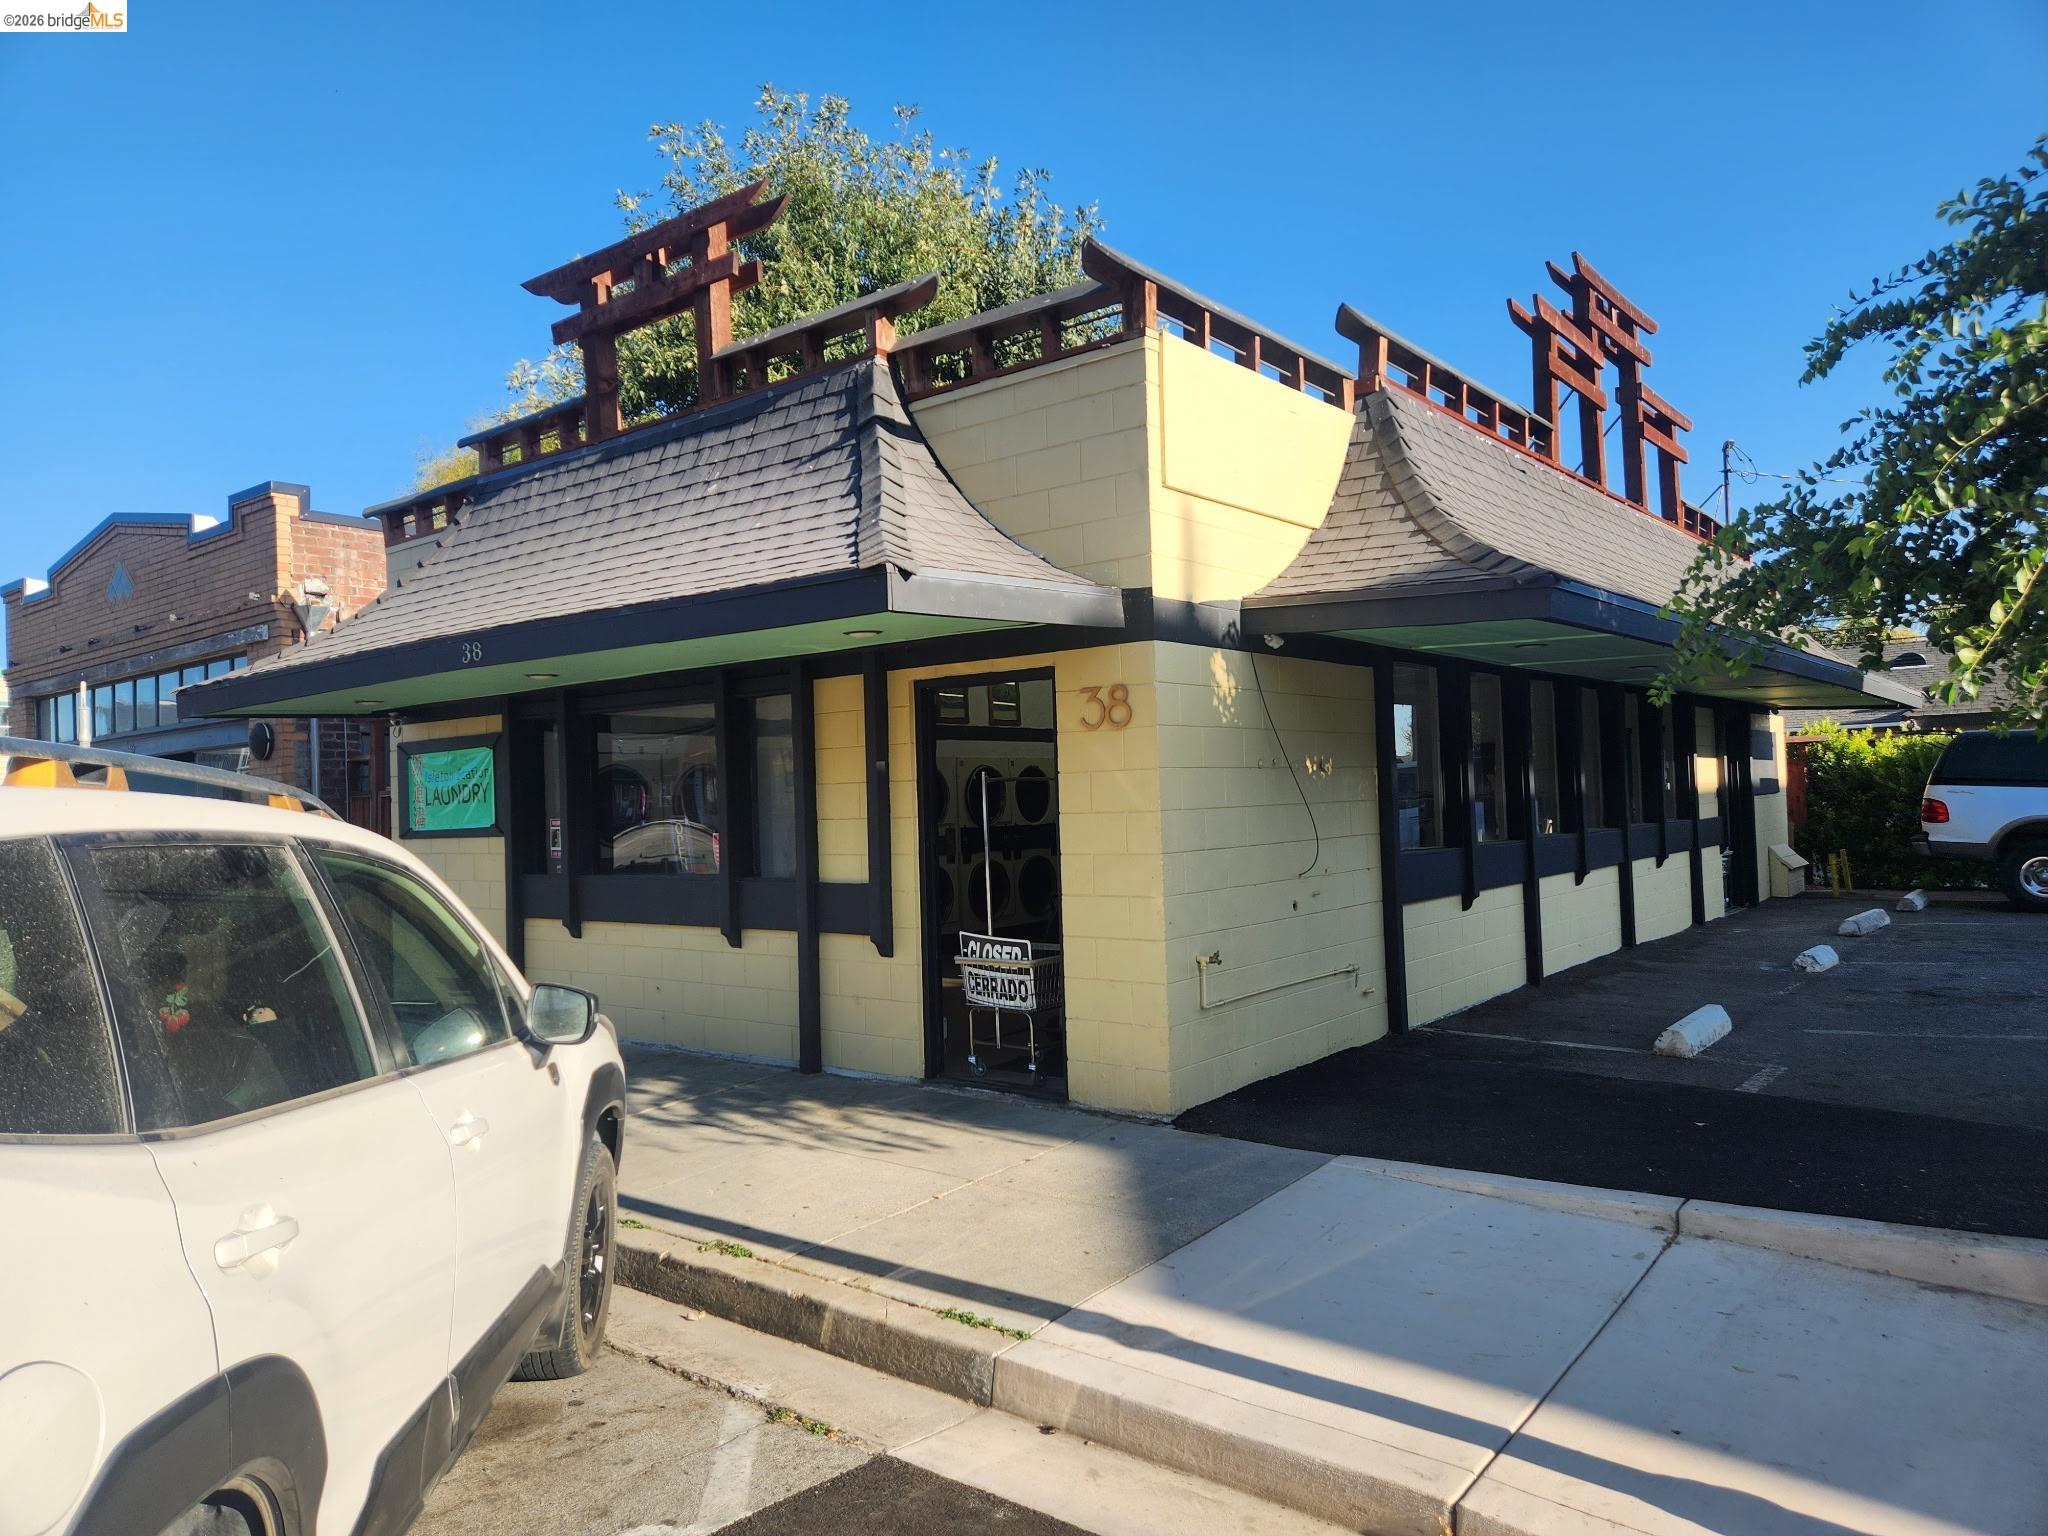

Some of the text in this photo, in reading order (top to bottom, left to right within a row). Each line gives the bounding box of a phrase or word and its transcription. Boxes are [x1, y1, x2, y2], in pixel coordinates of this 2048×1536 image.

[462, 641, 482, 664] 38
[1079, 683, 1133, 732] 38
[425, 782, 490, 806] LAUNDRY
[967, 970, 1029, 1003] CERRADO
